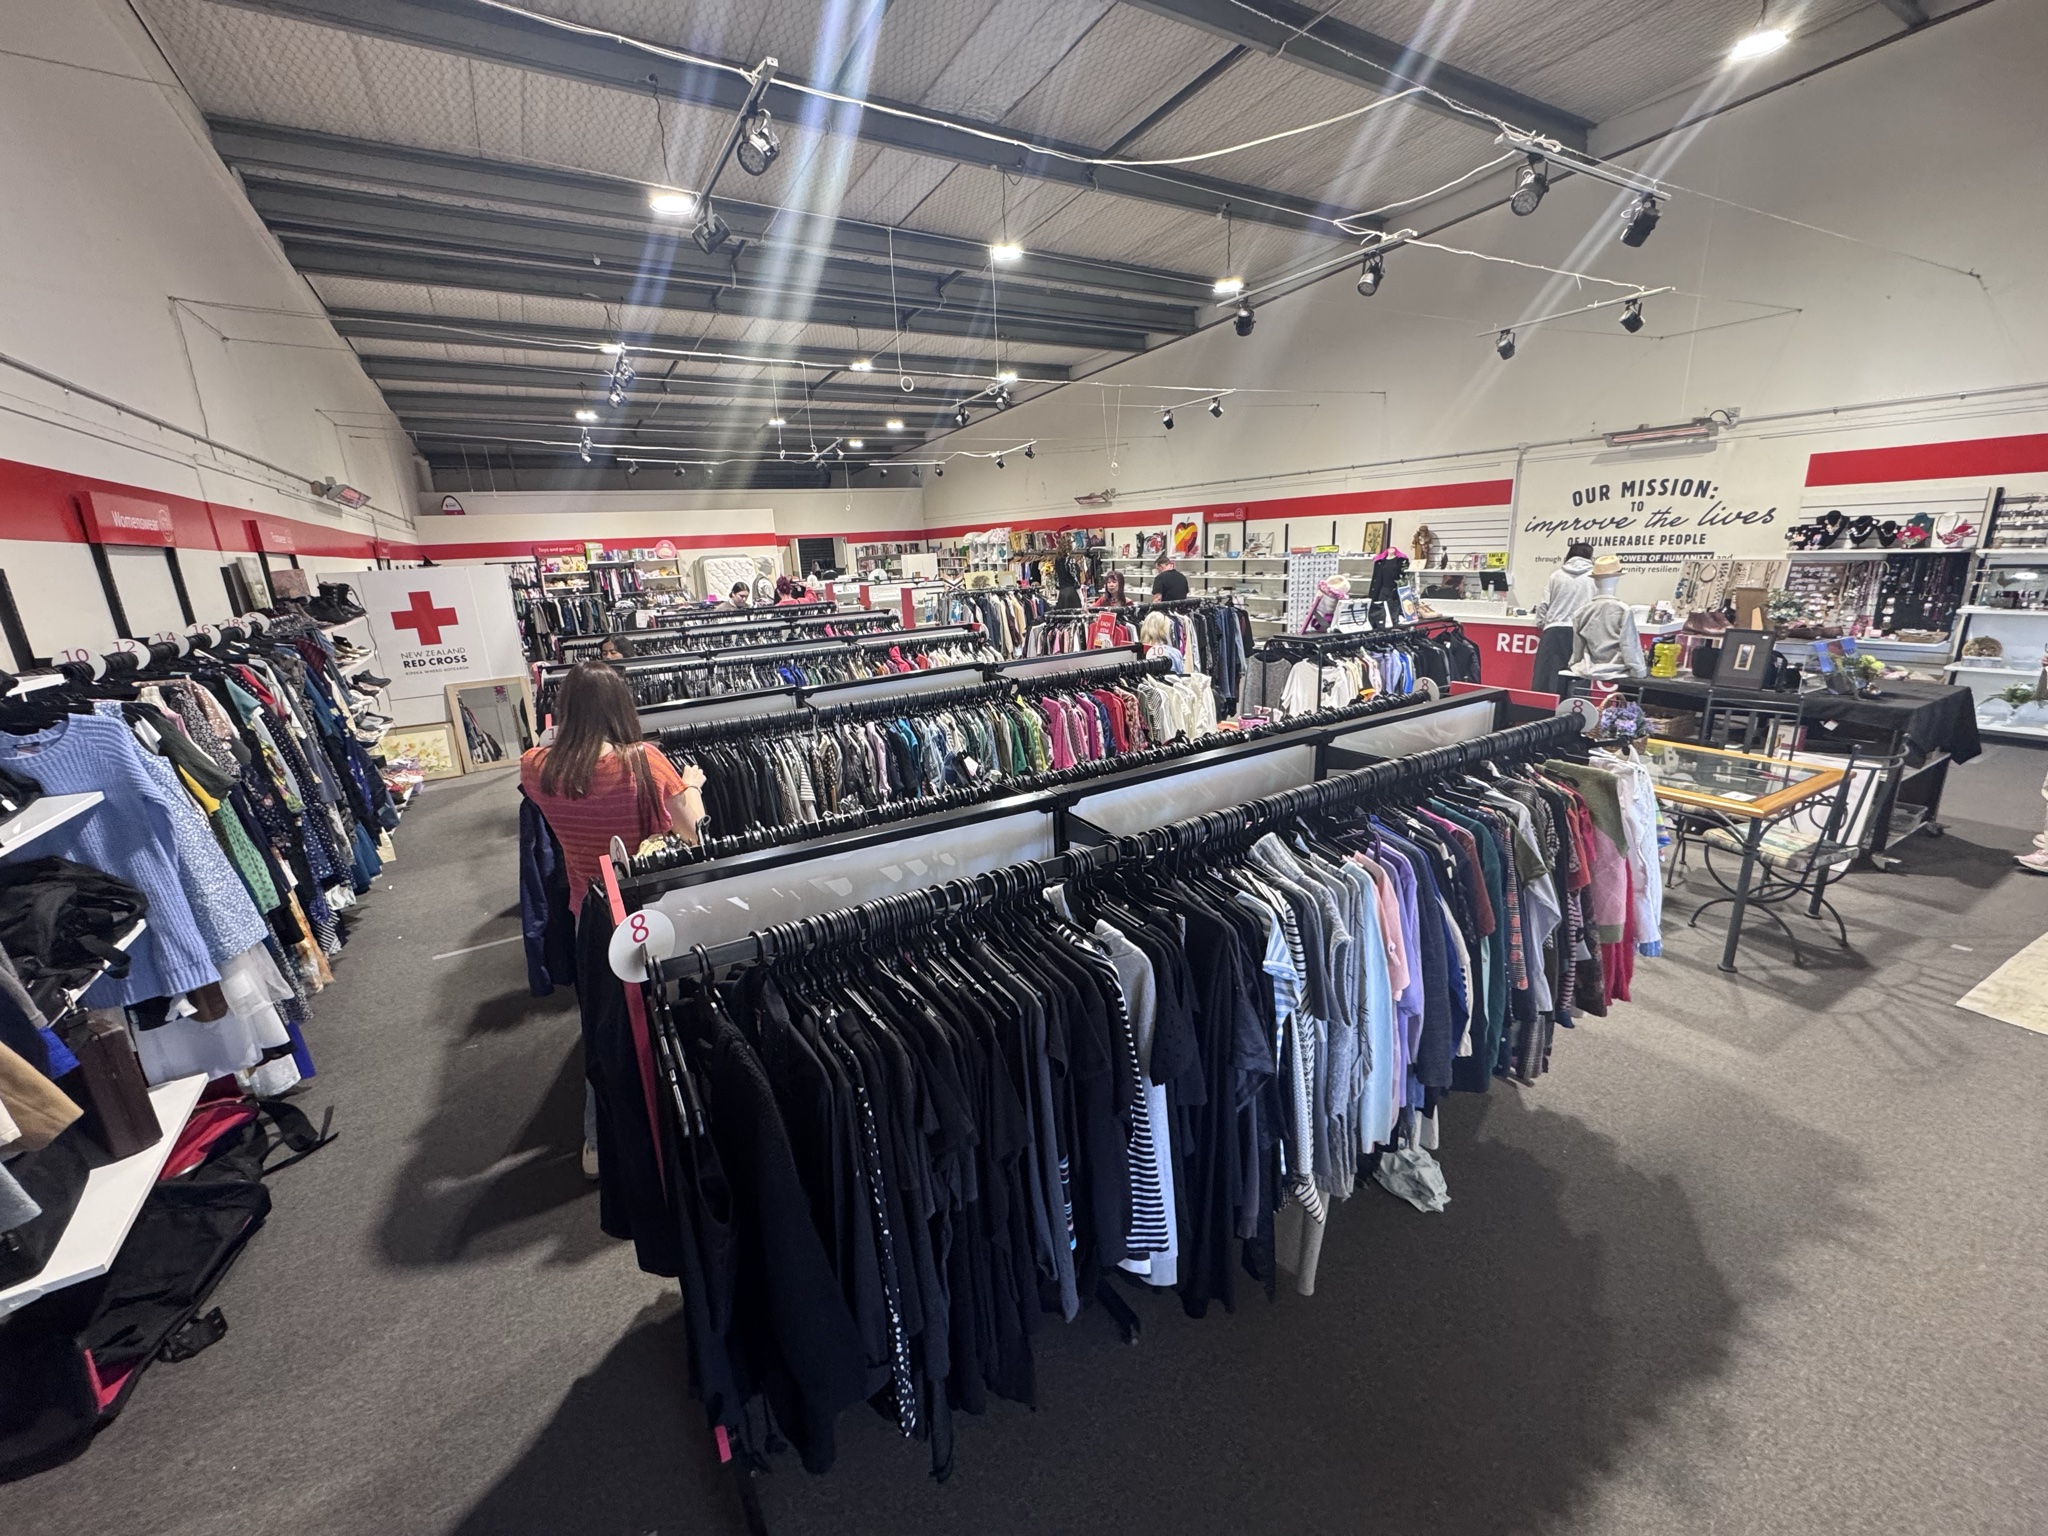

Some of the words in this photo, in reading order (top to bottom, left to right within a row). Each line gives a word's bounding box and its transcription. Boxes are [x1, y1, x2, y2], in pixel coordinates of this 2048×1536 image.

[1572, 484, 1610, 507] OUR
[1621, 479, 1719, 500] MISSION:
[1631, 501, 1644, 512] TO
[111, 510, 159, 531] Womenswear
[1524, 516, 1637, 538] improve
[1644, 506, 1689, 528] the
[1697, 500, 1777, 527] lives
[1567, 537, 1580, 547] OF
[1584, 535, 1655, 547] VULNERABLE
[1659, 534, 1706, 545] PEOPLE
[1535, 555, 1562, 564] through
[1662, 554, 1713, 562] HUMANITY
[193, 624, 211, 635] 16
[155, 632, 176, 643] 14
[1496, 633, 1541, 654] RED
[112, 641, 137, 655] 12
[400, 651, 423, 659] NEW
[425, 647, 466, 657] ZEALAND
[1152, 647, 1164, 656] 10
[61, 648, 90, 664] 10
[403, 659, 426, 668] RED
[429, 655, 468, 666] CROSS
[1422, 679, 1429, 691] 8
[1572, 700, 1583, 714] 8
[630, 913, 649, 943] 8
